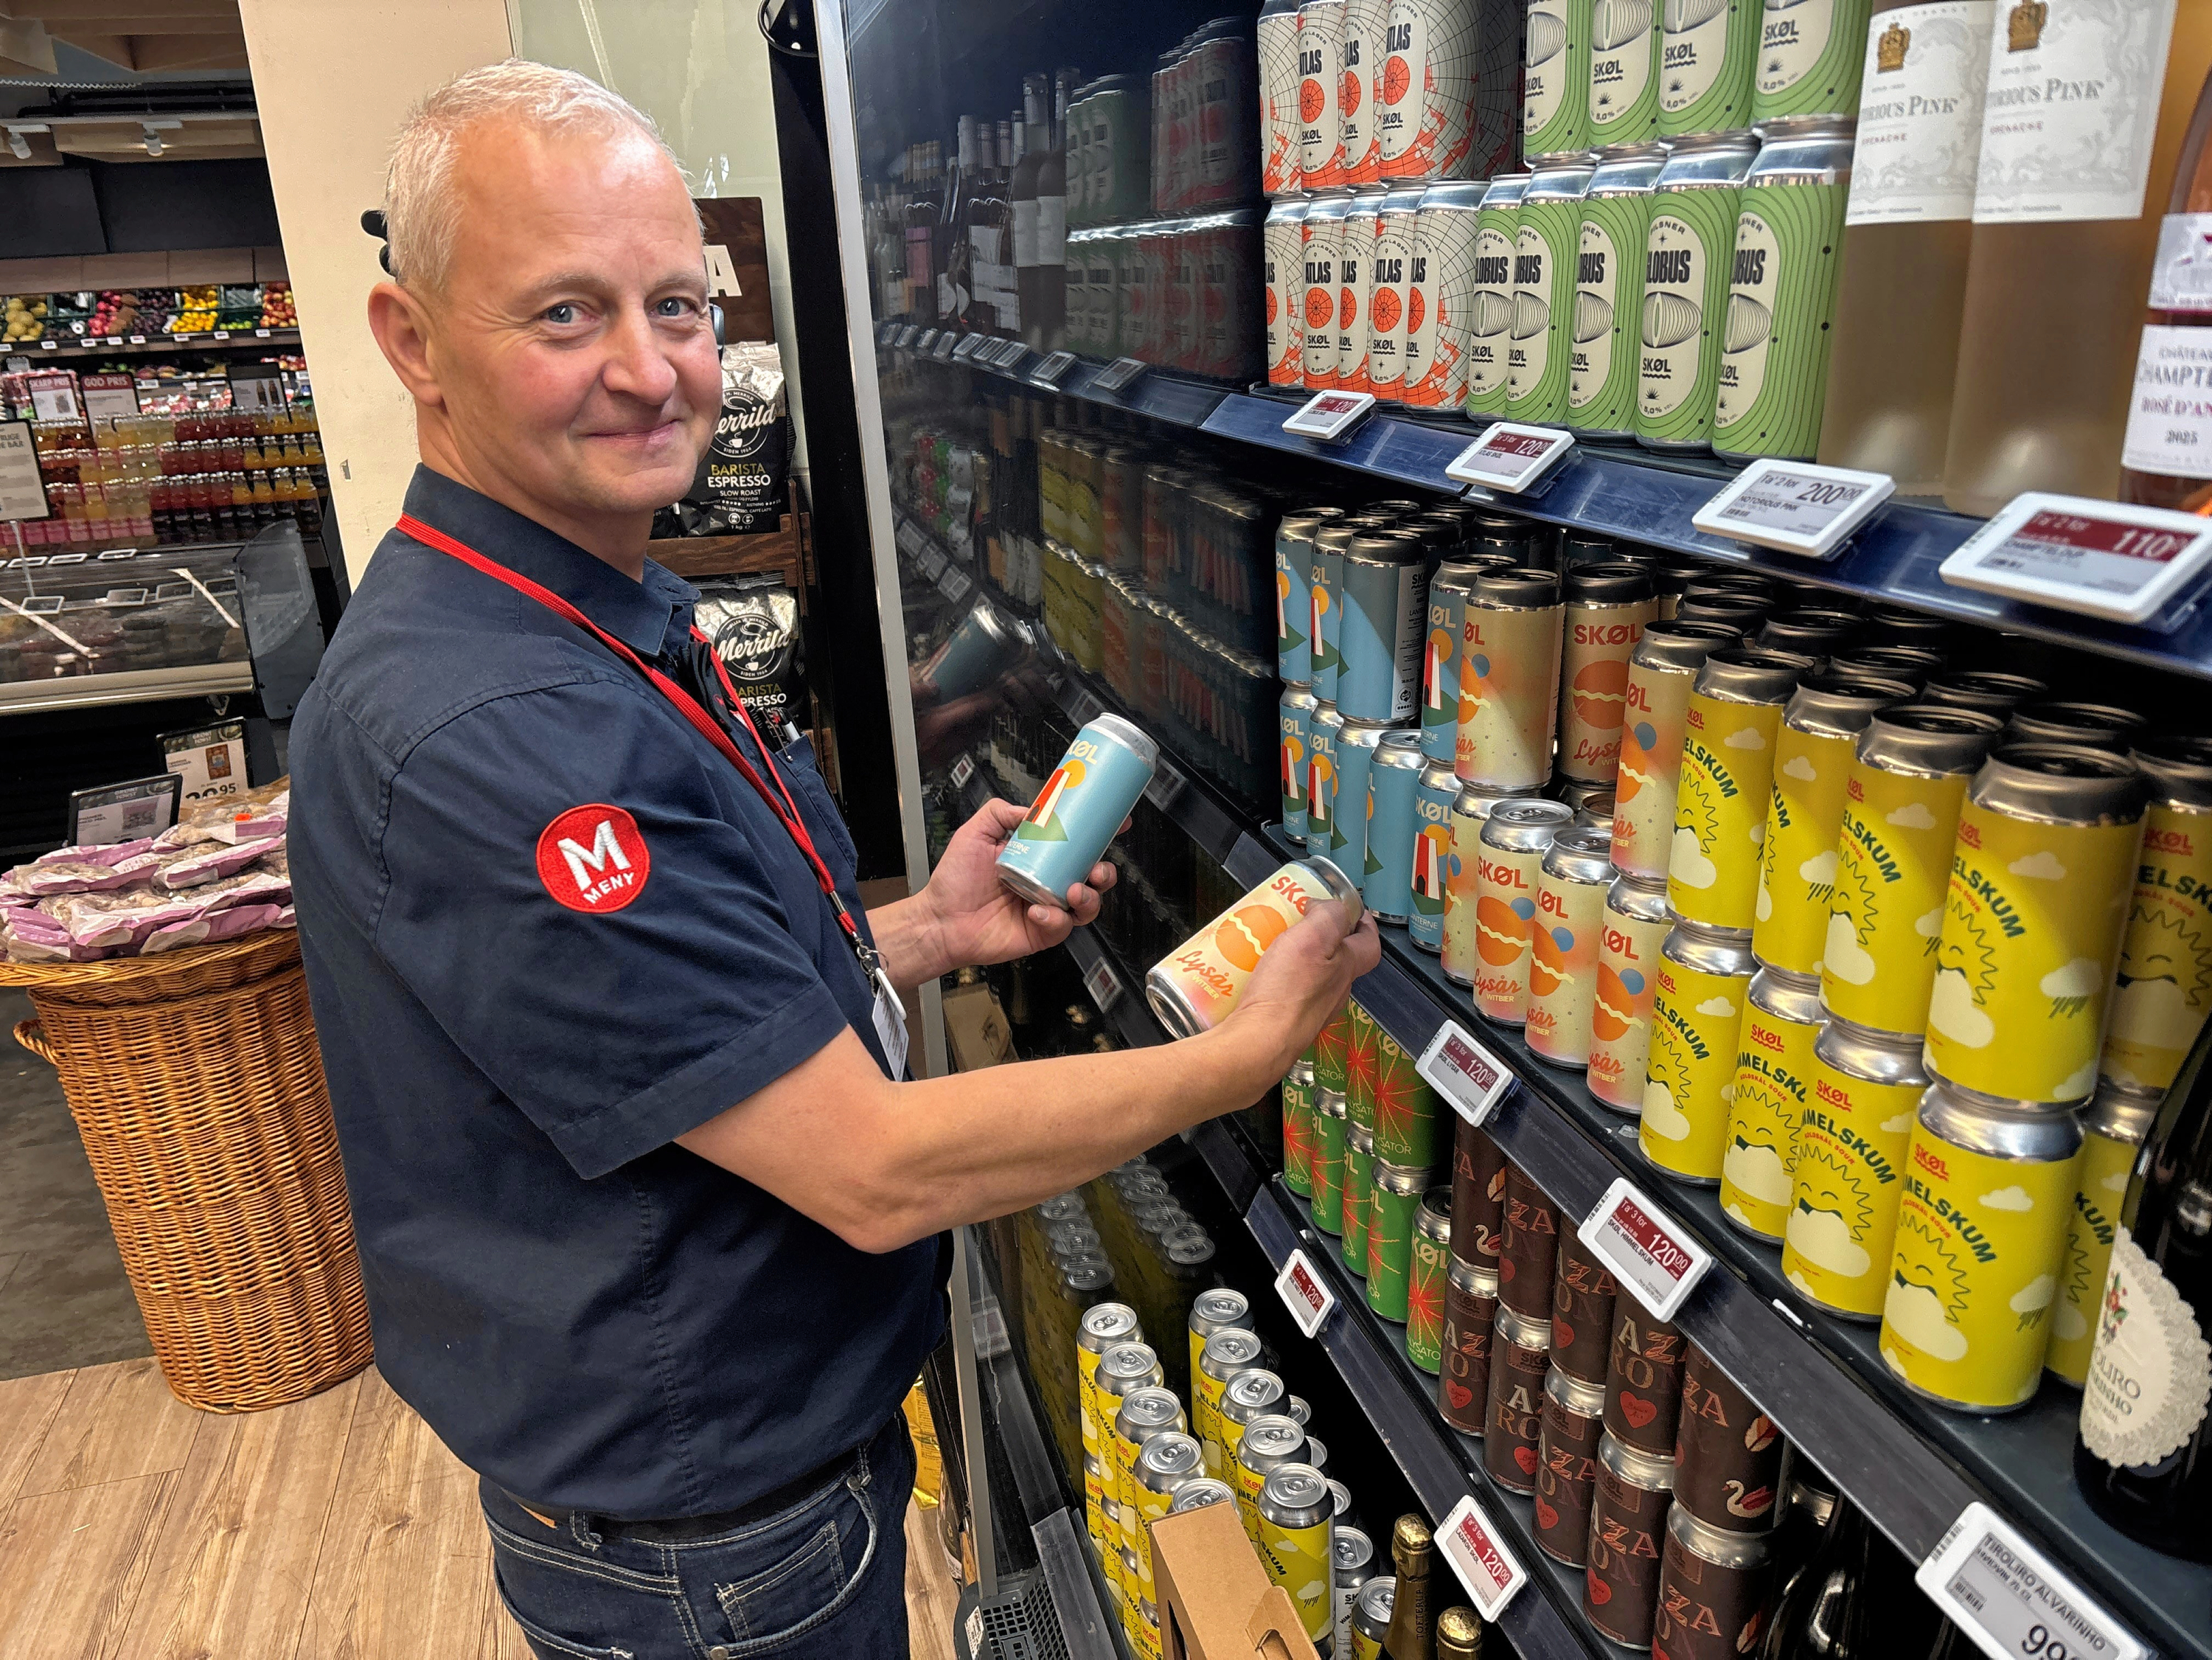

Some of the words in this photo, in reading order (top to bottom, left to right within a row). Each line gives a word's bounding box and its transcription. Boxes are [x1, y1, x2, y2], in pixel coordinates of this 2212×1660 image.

[1764, 18, 1800, 41] SKØL
[1665, 42, 1697, 63] SKØL
[1594, 59, 1623, 77] SKØL
[1526, 77, 1543, 90] KØL
[1345, 124, 1358, 134] KØL
[1382, 113, 1403, 125] SKØL
[1302, 129, 1322, 140] SKØL
[1305, 261, 1331, 284] ATLAS
[1375, 259, 1402, 283] ATLAS
[1475, 257, 1509, 284] LOBUS
[1514, 254, 1541, 284] OBUS
[1578, 252, 1605, 283] OBUS
[1308, 335, 1329, 344] SKØL
[1339, 337, 1352, 347] KØL
[1373, 339, 1395, 351] SKØL
[1406, 341, 1419, 353] KØL
[1471, 346, 1494, 358] SKØL
[1643, 357, 1672, 373] SKØL
[1720, 364, 1739, 381] KØL
[52, 376, 70, 388] PRIS
[83, 375, 105, 387] GOD
[107, 375, 129, 387] PRIS
[714, 403, 776, 435] errild
[1514, 439, 1540, 455] 120
[707, 474, 771, 487] ESPRESSO
[711, 462, 765, 476] BARISTA
[1774, 477, 1784, 487] 2
[1784, 479, 1799, 489] for
[1798, 482, 1845, 504] 200
[1844, 487, 1864, 500] 00
[2113, 529, 2176, 558] 110
[1311, 566, 1330, 585] ØL
[717, 628, 791, 662] Merrild
[1464, 622, 1485, 645] ØL
[1574, 624, 1642, 645] SKØL
[734, 684, 782, 698] ARISTA
[740, 693, 787, 707] PRESSO
[1684, 736, 1739, 799] ELSKUM
[219, 782, 237, 795] 95
[557, 820, 632, 892] M
[1843, 808, 1903, 883] ELSKUM
[1478, 855, 1528, 889] SKØL
[582, 872, 635, 905] MENY
[1954, 855, 2028, 939] ELSKUM
[1175, 951, 1233, 997] Lysår
[1474, 967, 1523, 995] Lysår
[1192, 975, 1220, 1000] WITBIER
[1486, 993, 1514, 1003] WITBIER
[1751, 1023, 1785, 1049] SKØL
[1448, 1037, 1457, 1046] Ta'
[1459, 1046, 1467, 1056] for
[1467, 1059, 1488, 1083] 120
[1486, 1073, 1495, 1084] 00
[1768, 1085, 1787, 1102] SOUR
[1816, 1079, 1852, 1107] SKØL
[1803, 1108, 1896, 1185] MMELSKUM
[1834, 1145, 1856, 1165] SOUR
[1914, 1143, 1950, 1175] SKØL
[1607, 1219, 1620, 1234] SKØL
[1620, 1230, 1655, 1266] HIMMELSKUM
[1620, 1200, 1632, 1213] Ta'
[1631, 1210, 1638, 1219] 3
[1636, 1215, 1648, 1228] for
[1648, 1234, 1677, 1267] 120
[1675, 1254, 1688, 1269] 00
[1306, 1284, 1319, 1305] 120
[1455, 1527, 1471, 1554] LAZARON
[1466, 1514, 1475, 1526] Ta'
[1482, 1548, 1503, 1577] 120
[1500, 1569, 1510, 1582] 00
[1984, 1535, 2036, 1587] TIROLIRO
[2035, 1584, 2106, 1652] ALVARINHO
